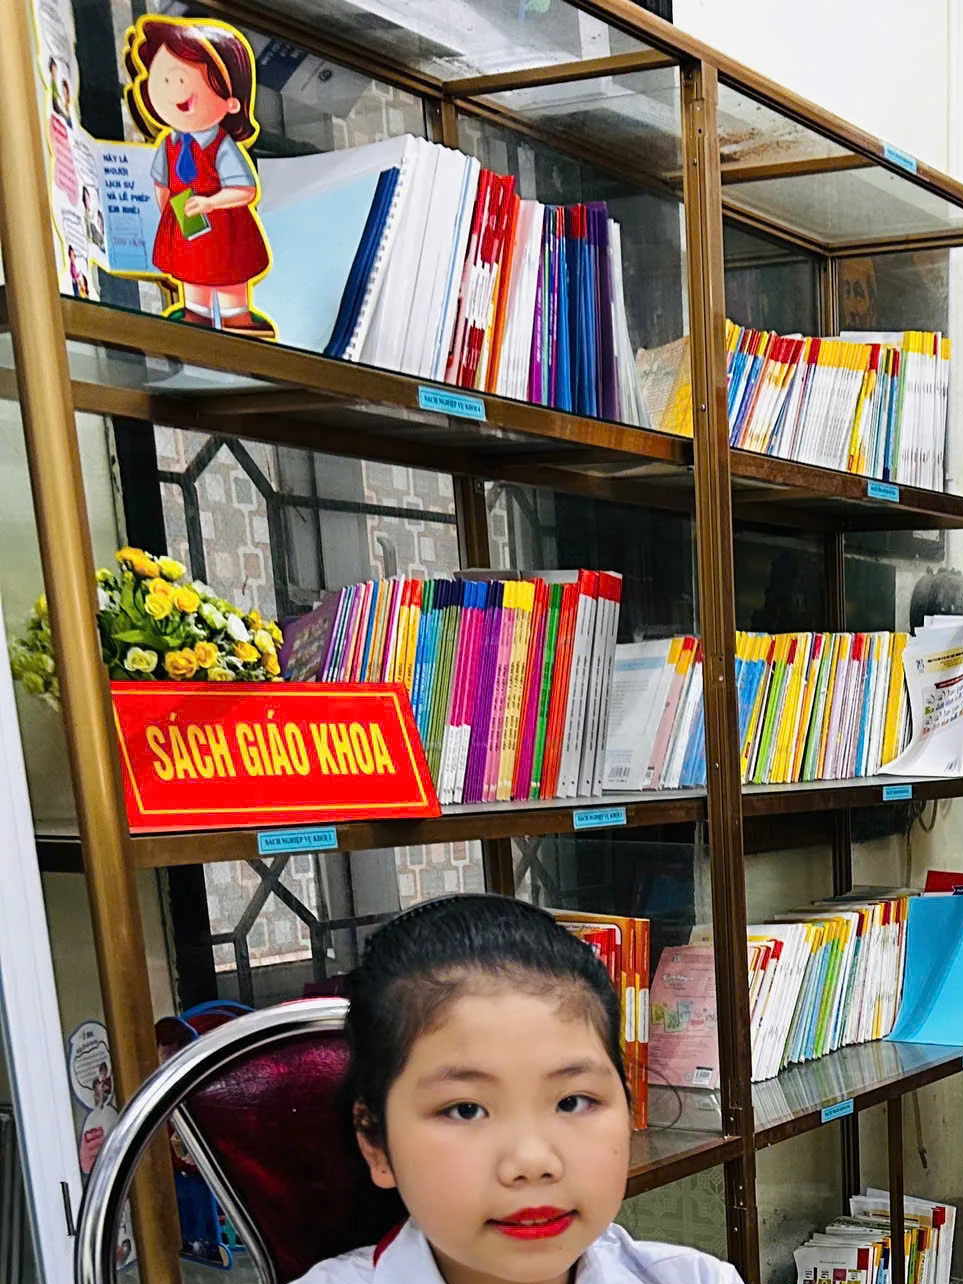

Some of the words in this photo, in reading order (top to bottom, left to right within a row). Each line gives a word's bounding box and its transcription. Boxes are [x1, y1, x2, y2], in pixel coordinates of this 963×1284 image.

[146, 712, 236, 781] SÁCH
[236, 710, 311, 776] GIÁO
[311, 722, 396, 775] KHOA
